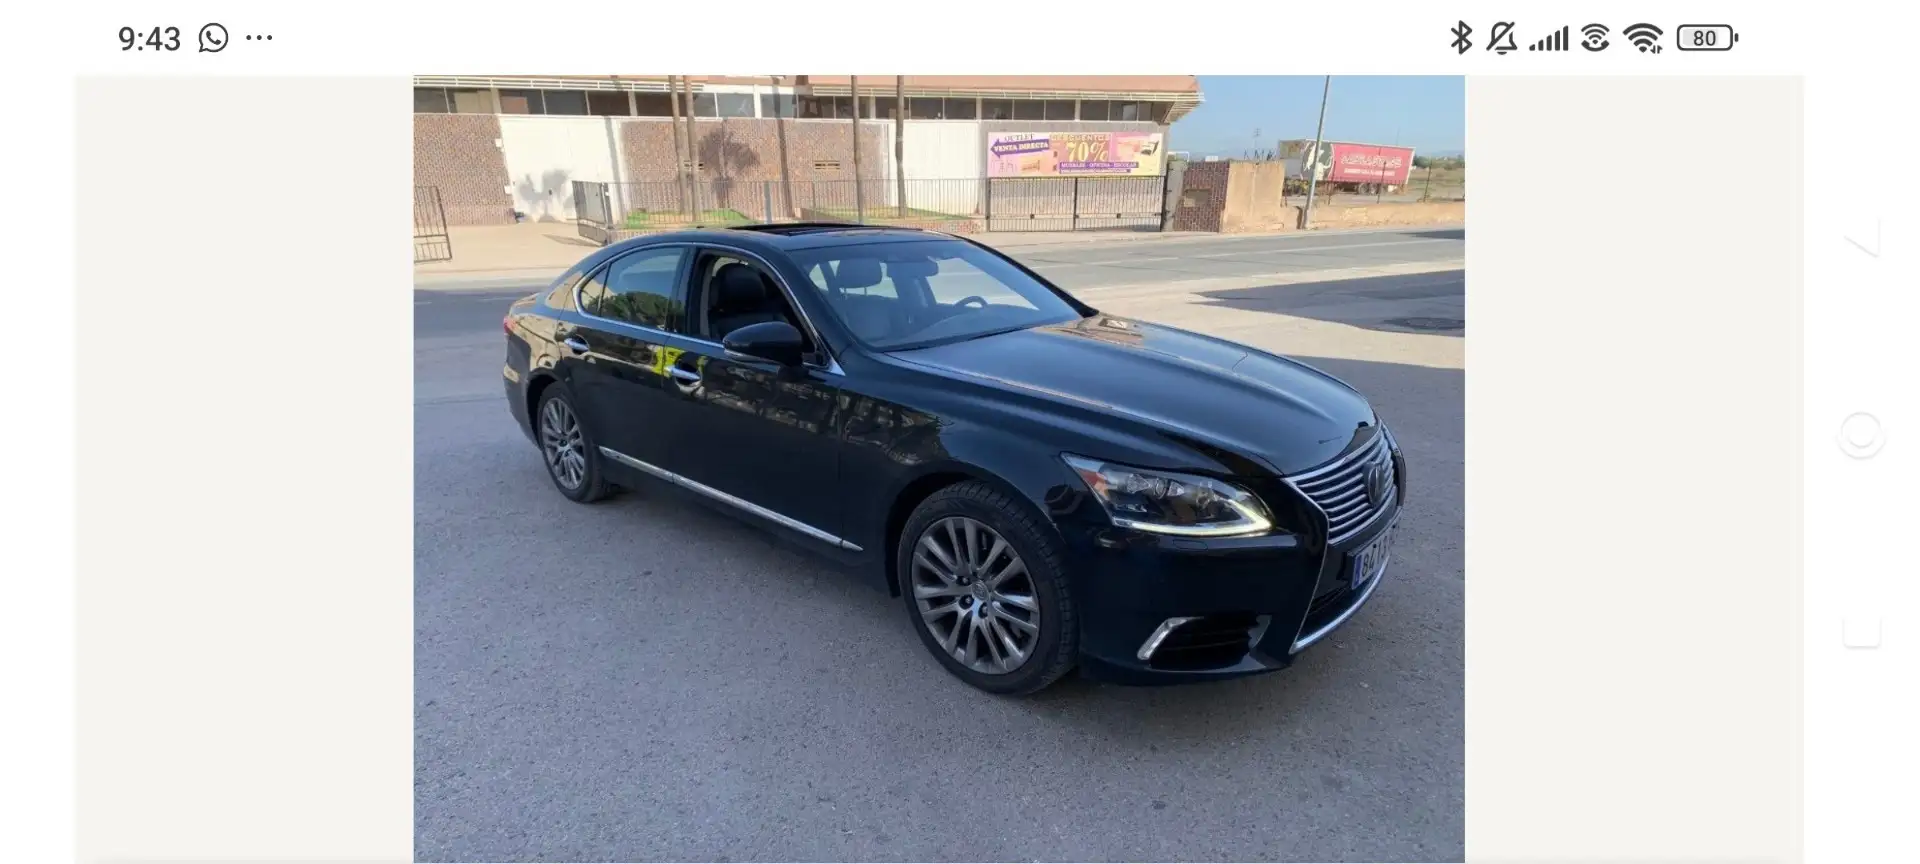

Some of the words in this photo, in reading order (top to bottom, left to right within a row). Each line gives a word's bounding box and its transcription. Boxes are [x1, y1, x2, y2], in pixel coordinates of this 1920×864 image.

[1004, 133, 1034, 141] OUTLET
[994, 143, 1017, 152] VENTA
[1018, 141, 1048, 150] DIRECTA
[1066, 141, 1108, 162] 70%
